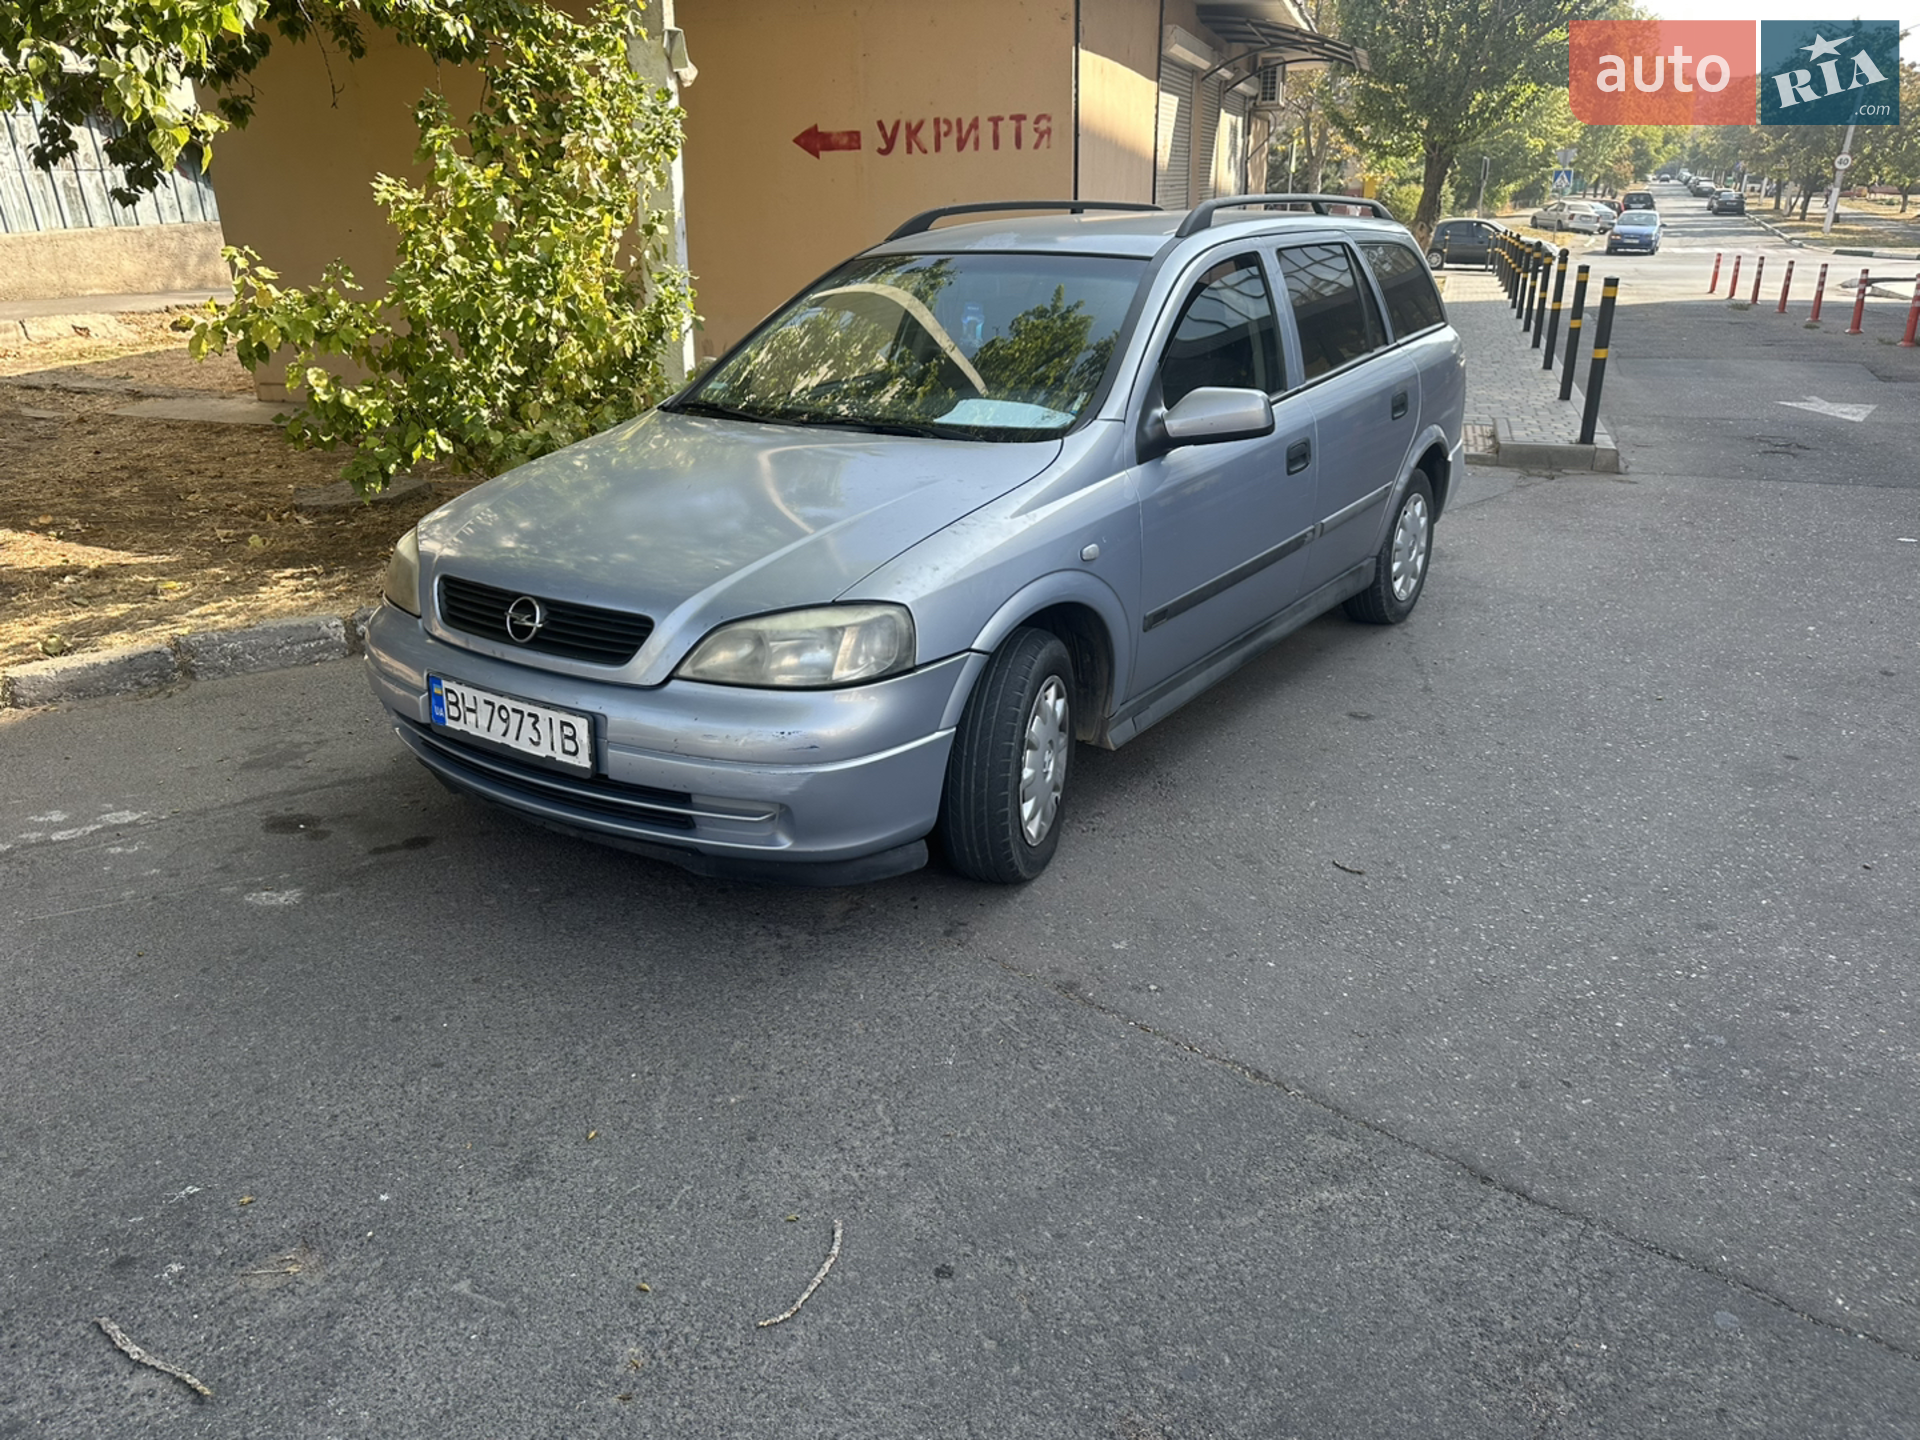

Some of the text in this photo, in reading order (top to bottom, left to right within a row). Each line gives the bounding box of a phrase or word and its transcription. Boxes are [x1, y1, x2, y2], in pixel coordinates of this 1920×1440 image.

[876, 113, 1053, 156] УКРИТТЯ
[1836, 157, 1850, 166] 40
[434, 704, 445, 717] UA
